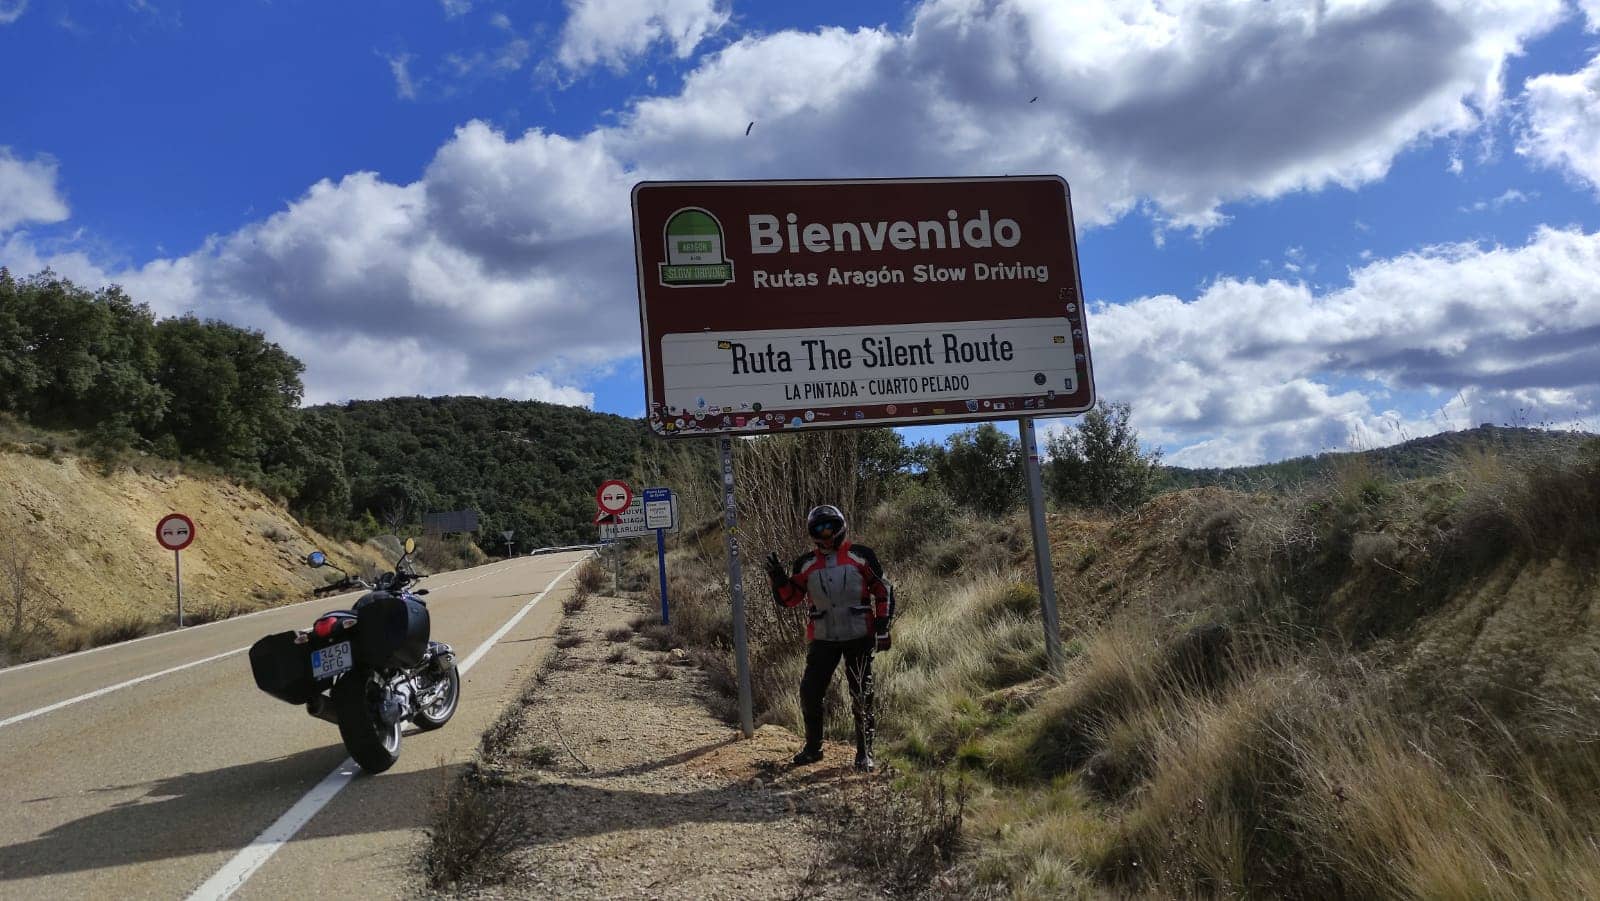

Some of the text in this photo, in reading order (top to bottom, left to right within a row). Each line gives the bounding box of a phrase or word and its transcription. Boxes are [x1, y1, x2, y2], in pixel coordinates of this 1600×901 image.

[749, 210, 1021, 254] Bienvenido
[753, 261, 1049, 289] Rutas Aragón Slow Driving
[731, 332, 1014, 375] Ruta The Silent Route
[784, 383, 802, 401] LA
[804, 380, 859, 400] PINTADA
[868, 376, 918, 396] CUARTO
[921, 374, 970, 393] PELADO
[320, 643, 349, 661] 3450
